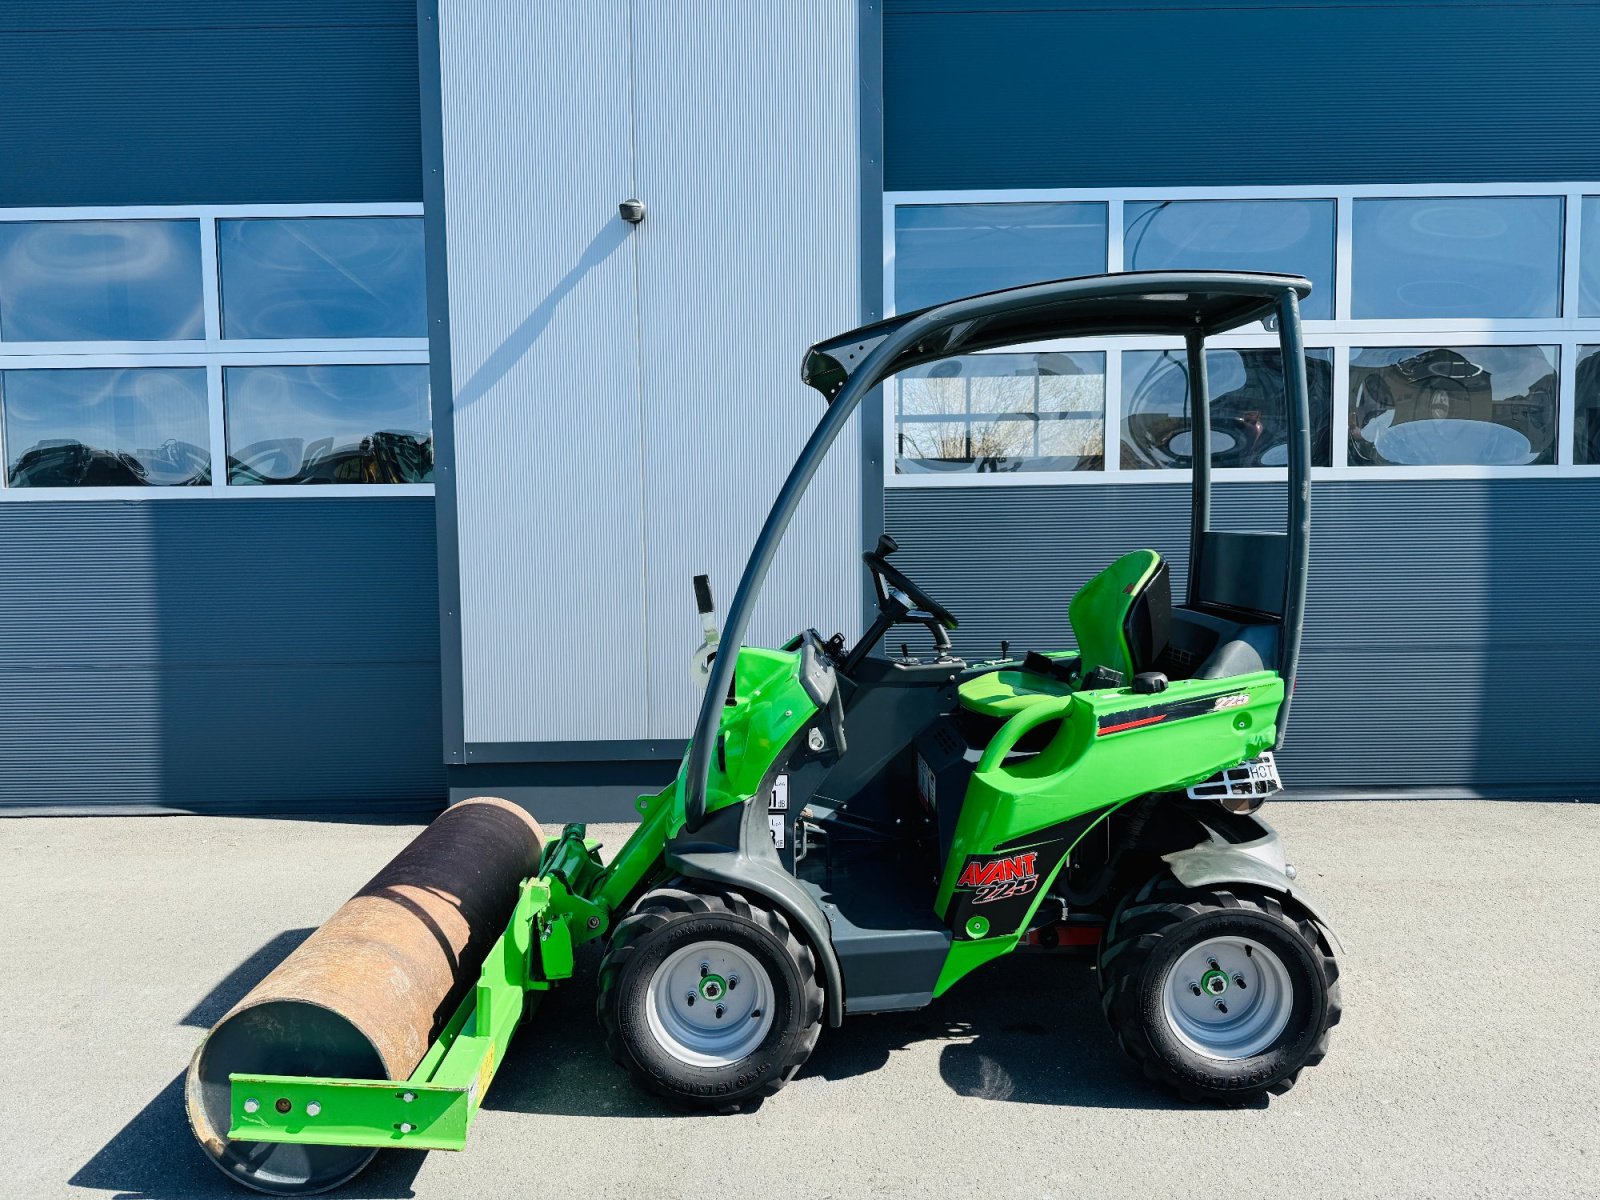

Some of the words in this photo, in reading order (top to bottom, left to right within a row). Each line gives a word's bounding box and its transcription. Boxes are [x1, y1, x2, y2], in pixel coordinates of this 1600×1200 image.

[1250, 764, 1274, 779] HOT
[957, 852, 1038, 887] AVANT
[972, 874, 1040, 905] 225
